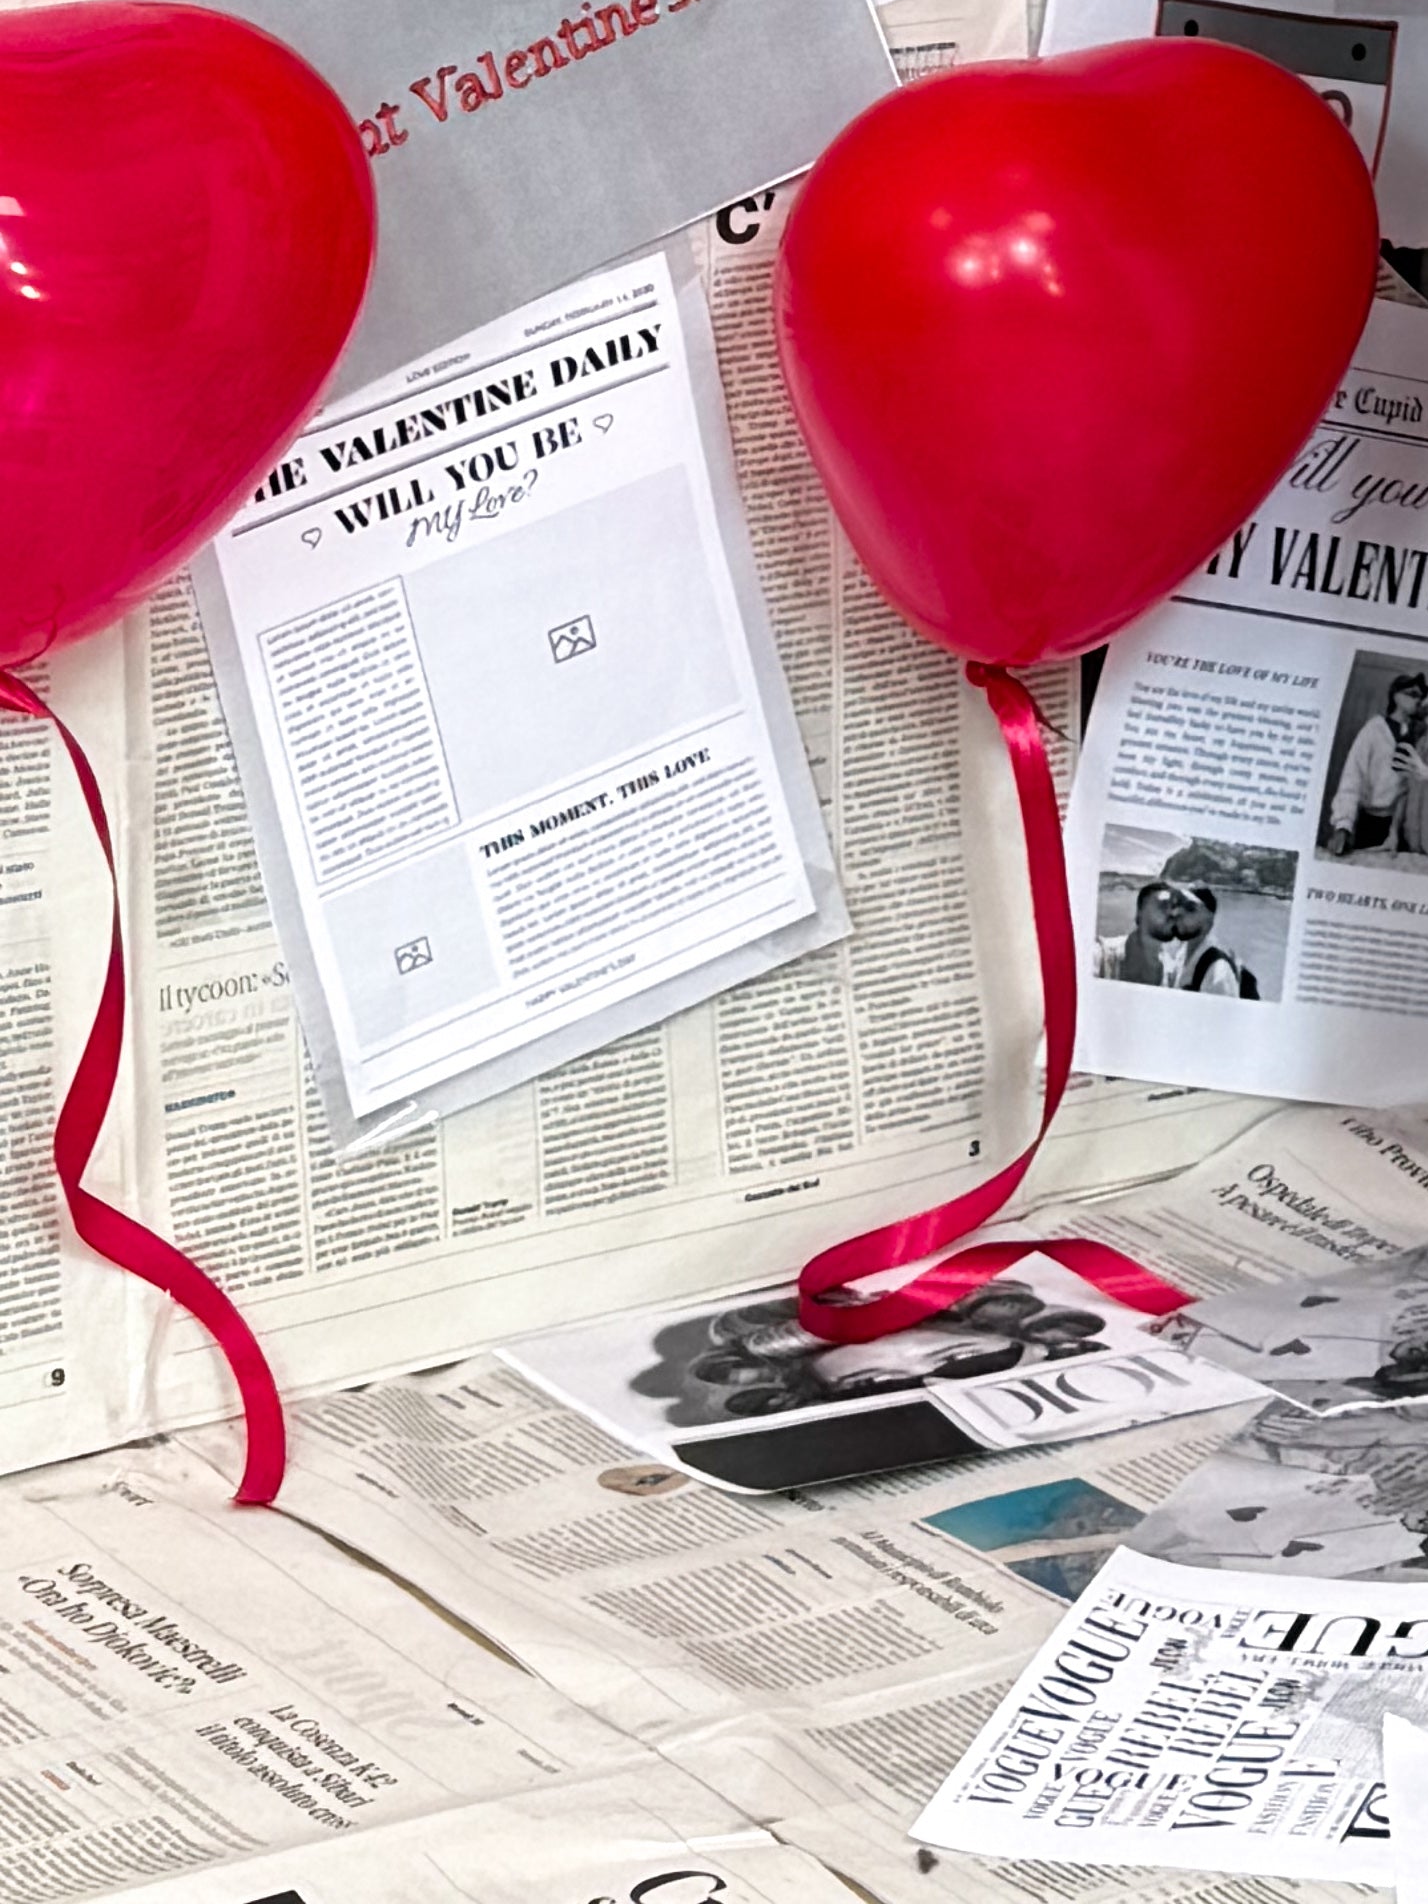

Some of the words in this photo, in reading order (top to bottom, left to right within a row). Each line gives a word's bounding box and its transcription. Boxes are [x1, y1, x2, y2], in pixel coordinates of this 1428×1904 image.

[317, 369, 539, 473] VALENTINE
[549, 321, 664, 391] DAILY
[1353, 386, 1424, 430] Cupid
[333, 480, 435, 537] WILL
[443, 443, 522, 492] YOU
[532, 414, 585, 462] BE
[478, 824, 527, 861] THIS
[615, 764, 662, 795] THIS
[663, 745, 713, 781] LOVE
